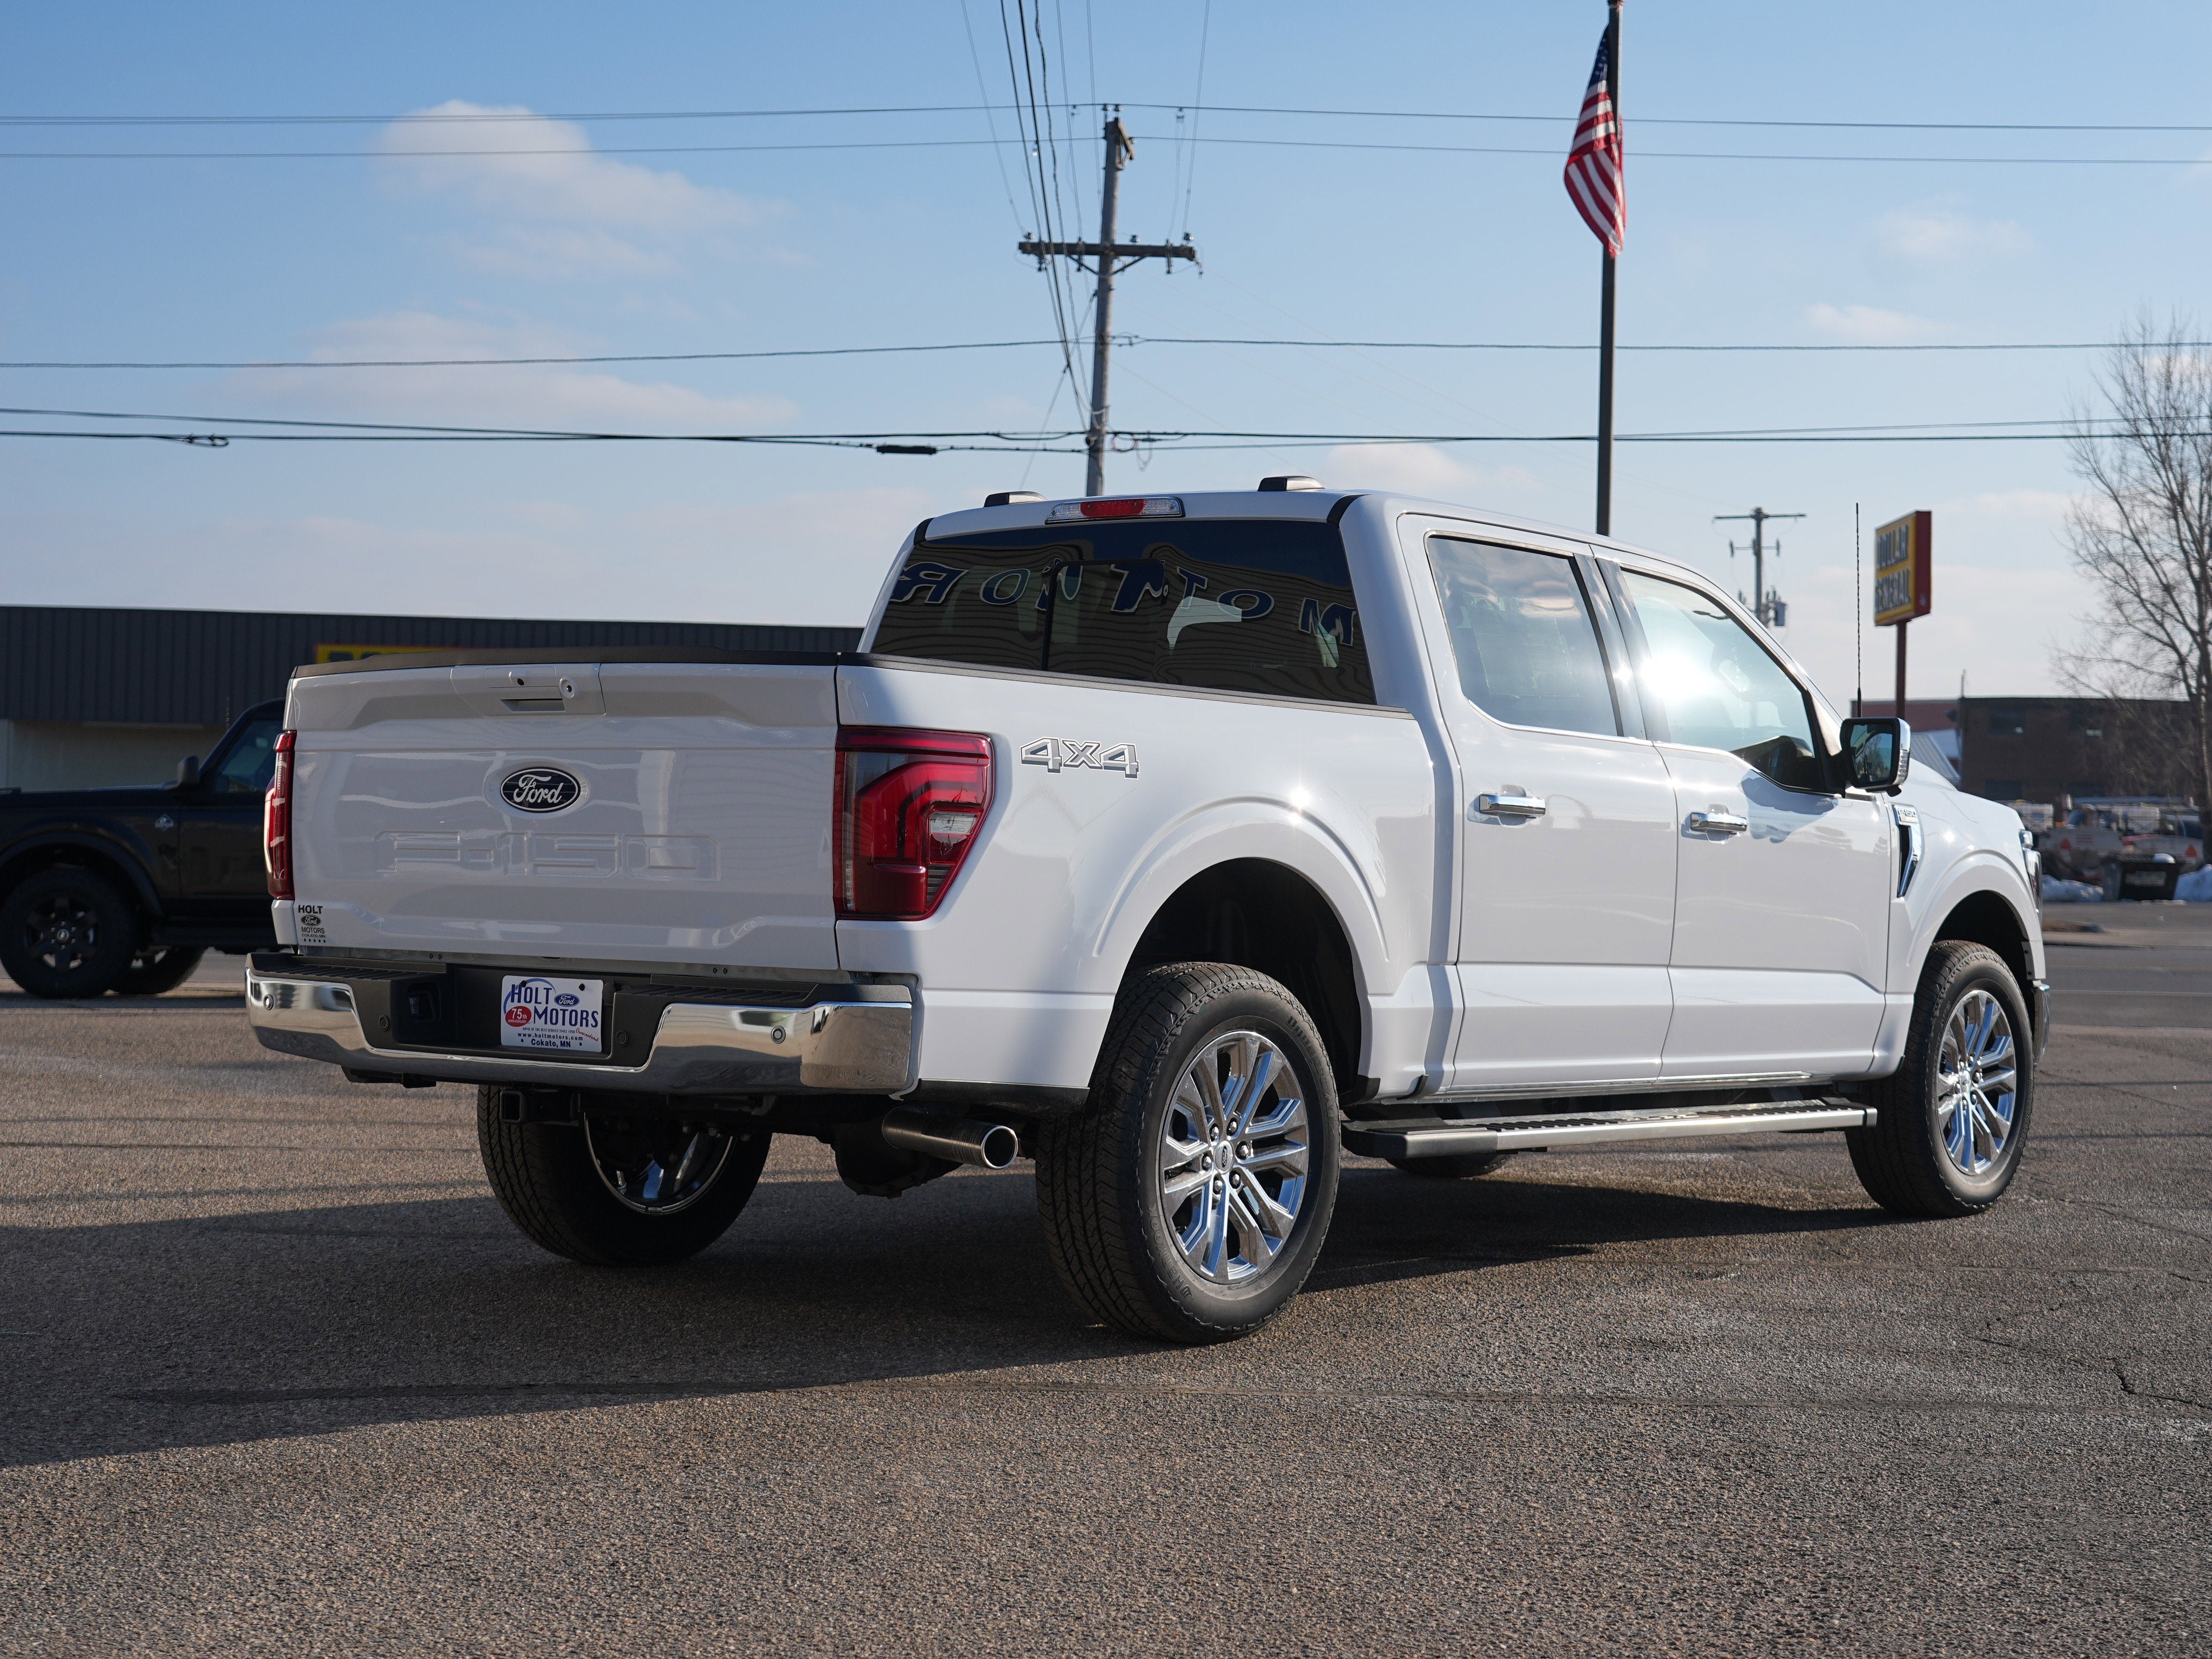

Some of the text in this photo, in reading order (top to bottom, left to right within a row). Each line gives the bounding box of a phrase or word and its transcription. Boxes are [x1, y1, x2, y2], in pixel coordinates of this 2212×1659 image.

[513, 774, 562, 804] Ford
[298, 905, 323, 914] HOLT
[511, 984, 552, 1004] HOLT
[558, 994, 576, 1006] Ford
[511, 1008, 527, 1020] 75th
[534, 1006, 598, 1028] MOTORS
[517, 1032, 583, 1041] www.holtmotors.com
[531, 1038, 558, 1048] Cokato,
